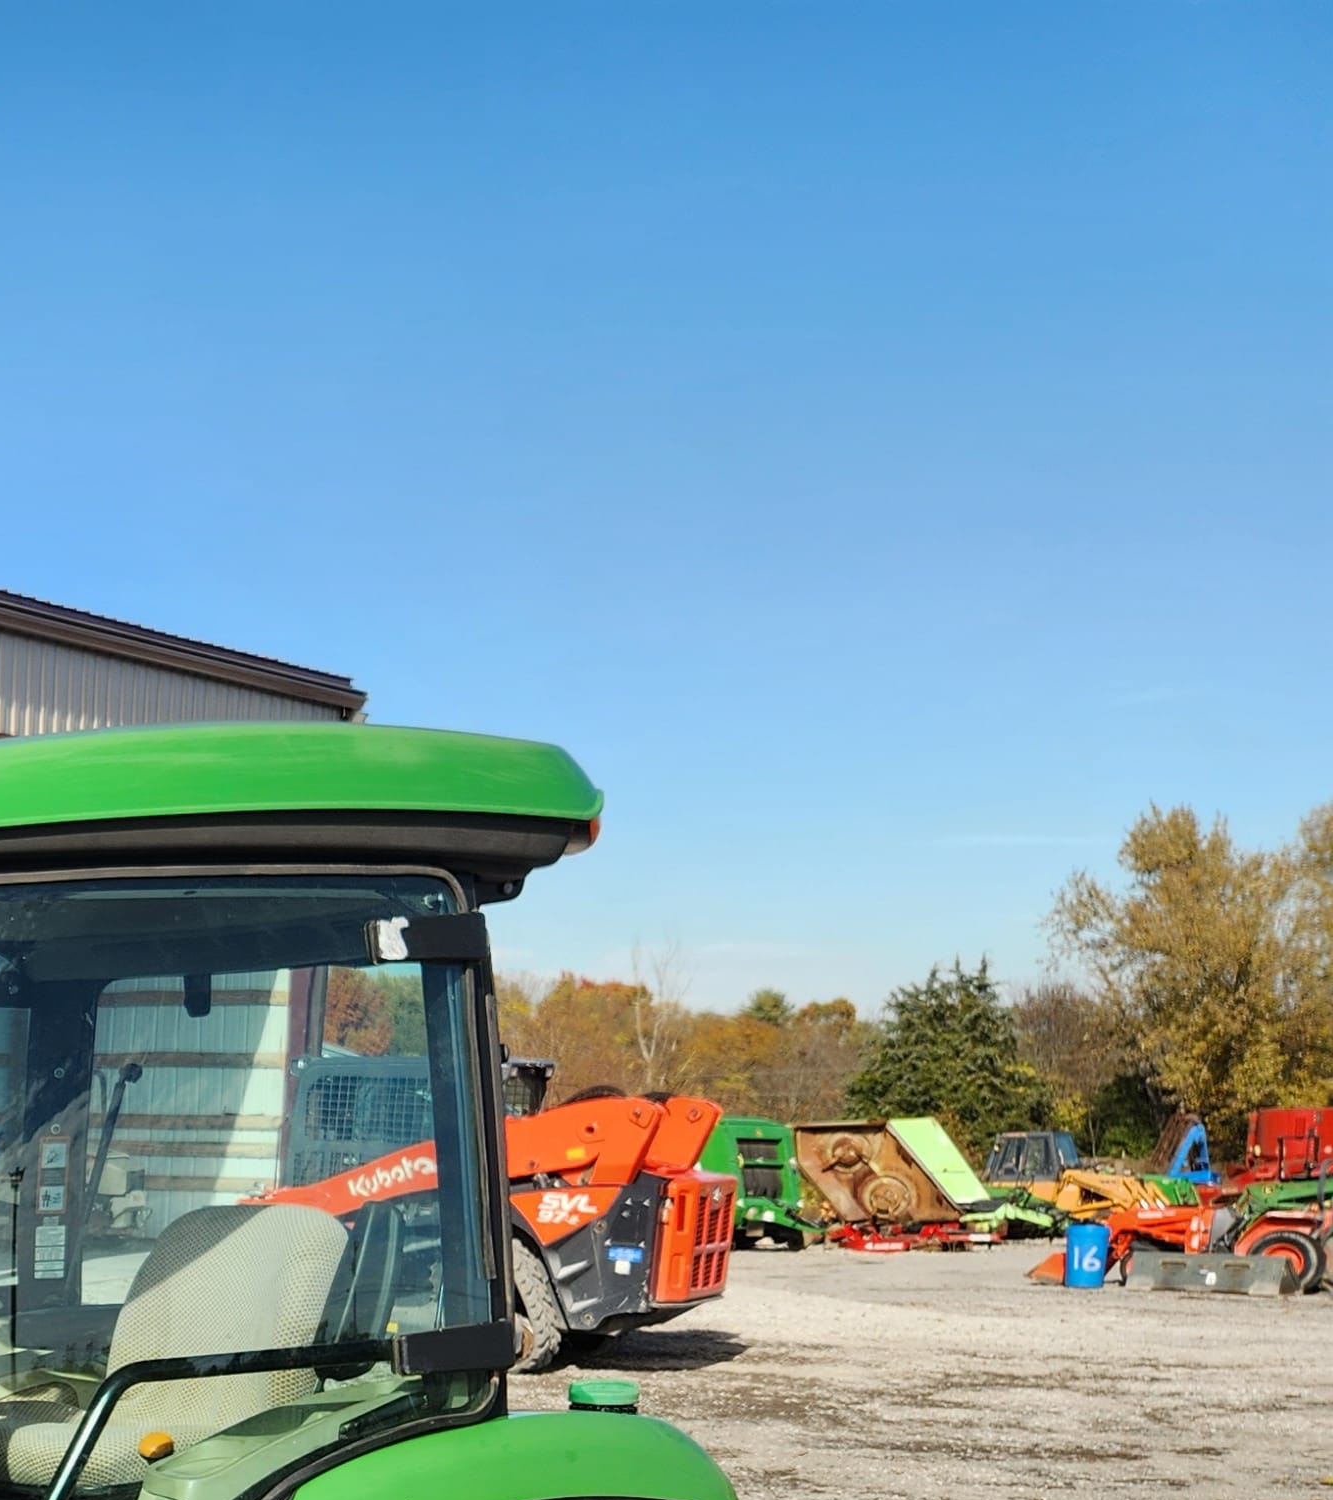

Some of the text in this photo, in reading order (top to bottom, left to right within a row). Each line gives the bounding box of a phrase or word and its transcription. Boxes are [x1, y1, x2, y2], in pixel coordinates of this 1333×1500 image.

[347, 1155, 437, 1198] Kubota
[537, 1191, 598, 1214] SVL
[1073, 1244, 1102, 1273] 16
